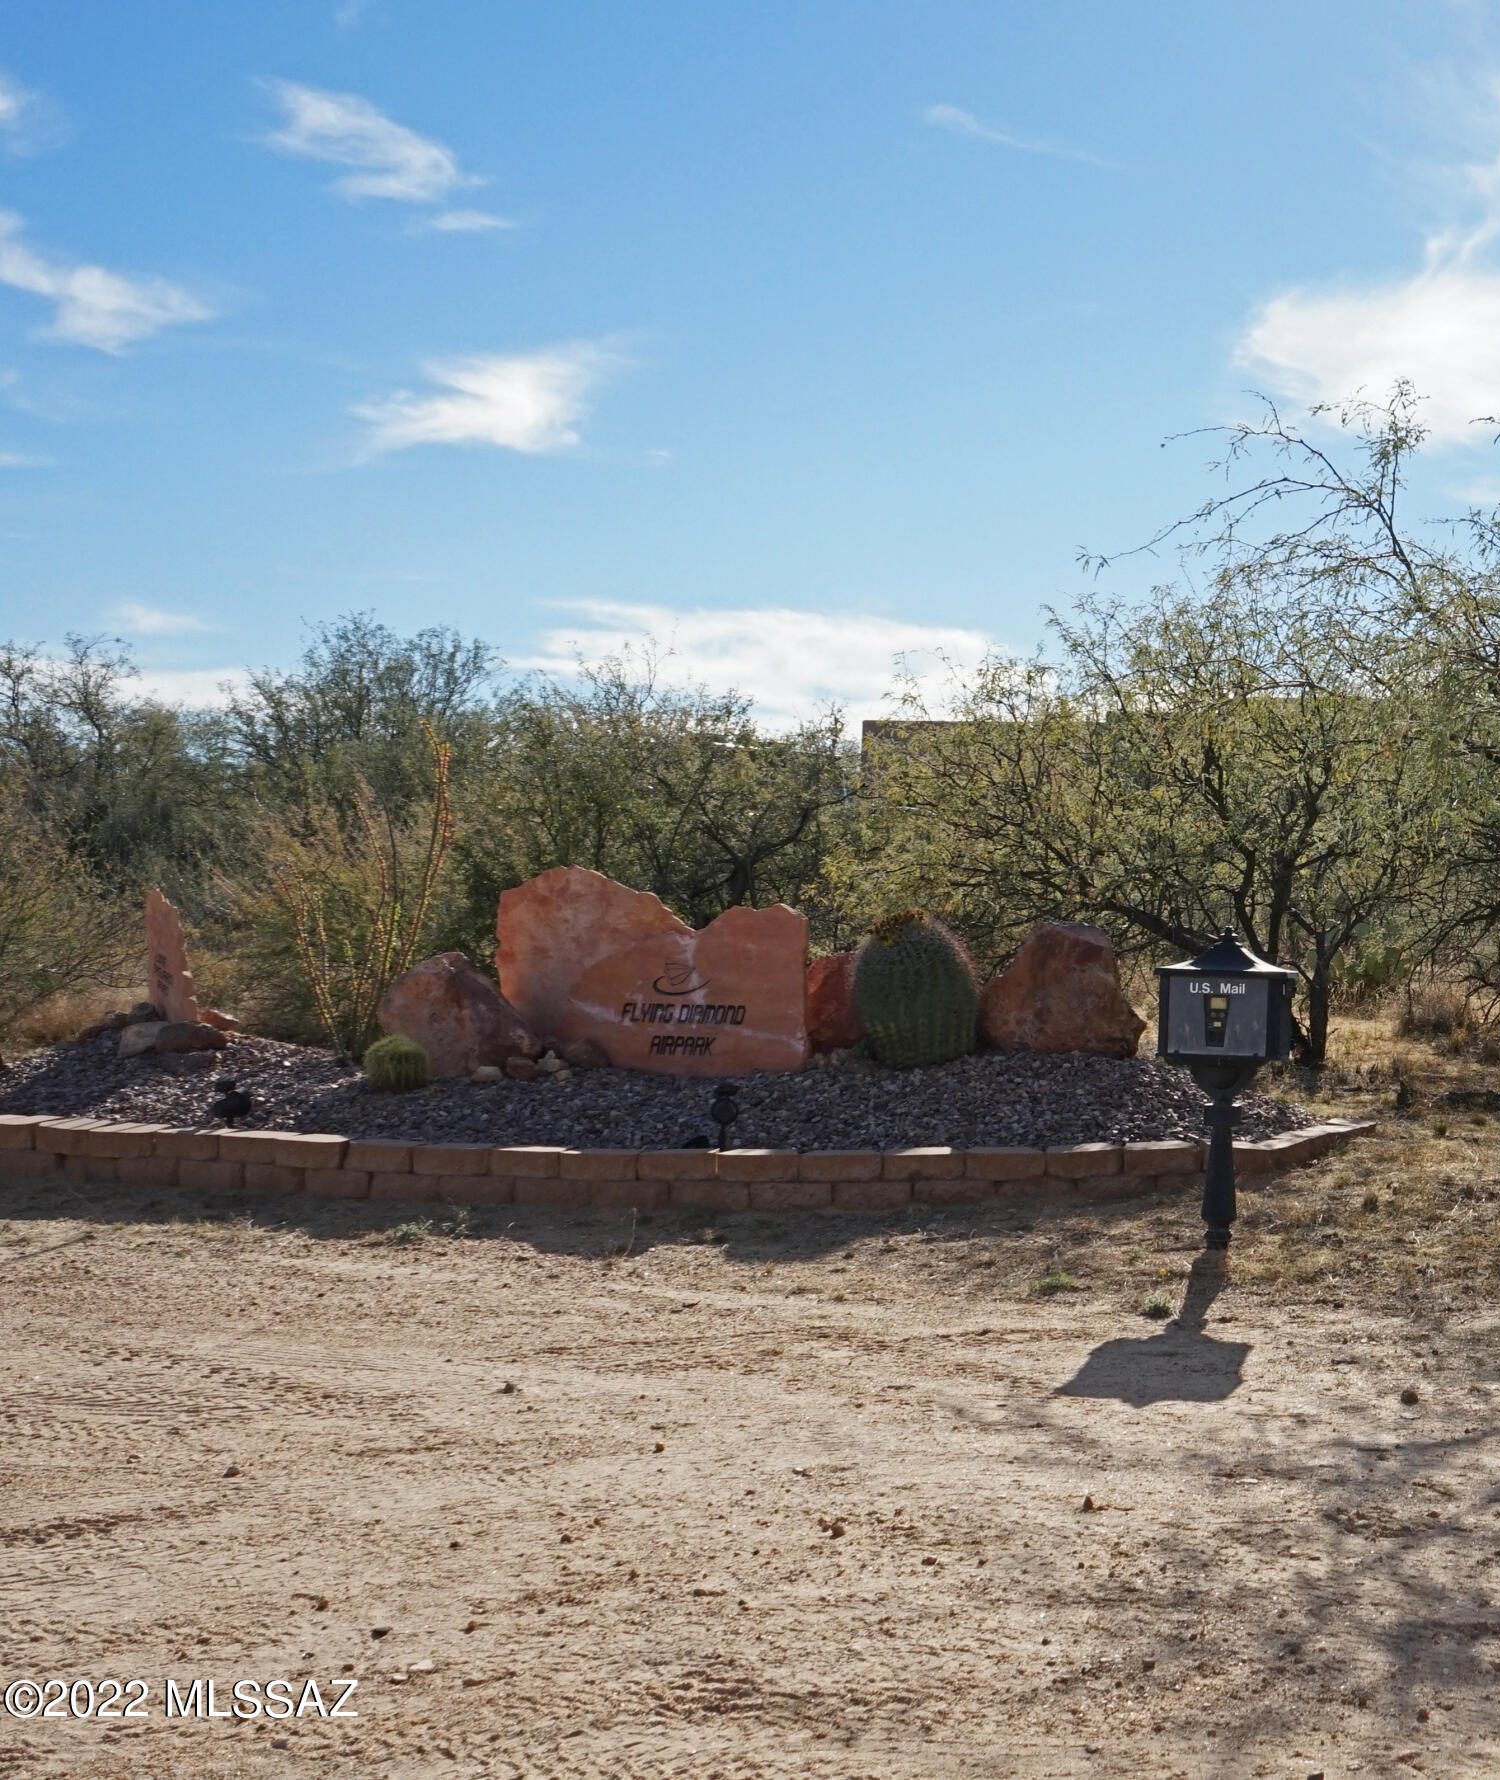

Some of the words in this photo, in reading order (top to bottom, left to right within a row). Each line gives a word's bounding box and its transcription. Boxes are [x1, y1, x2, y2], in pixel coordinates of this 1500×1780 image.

[1191, 983, 1212, 993] U.S.
[1221, 984, 1244, 993] Mail
[621, 1003, 674, 1023] FLYING
[678, 1004, 746, 1025] DIAMOND
[650, 1036, 716, 1056] AIRPARK
